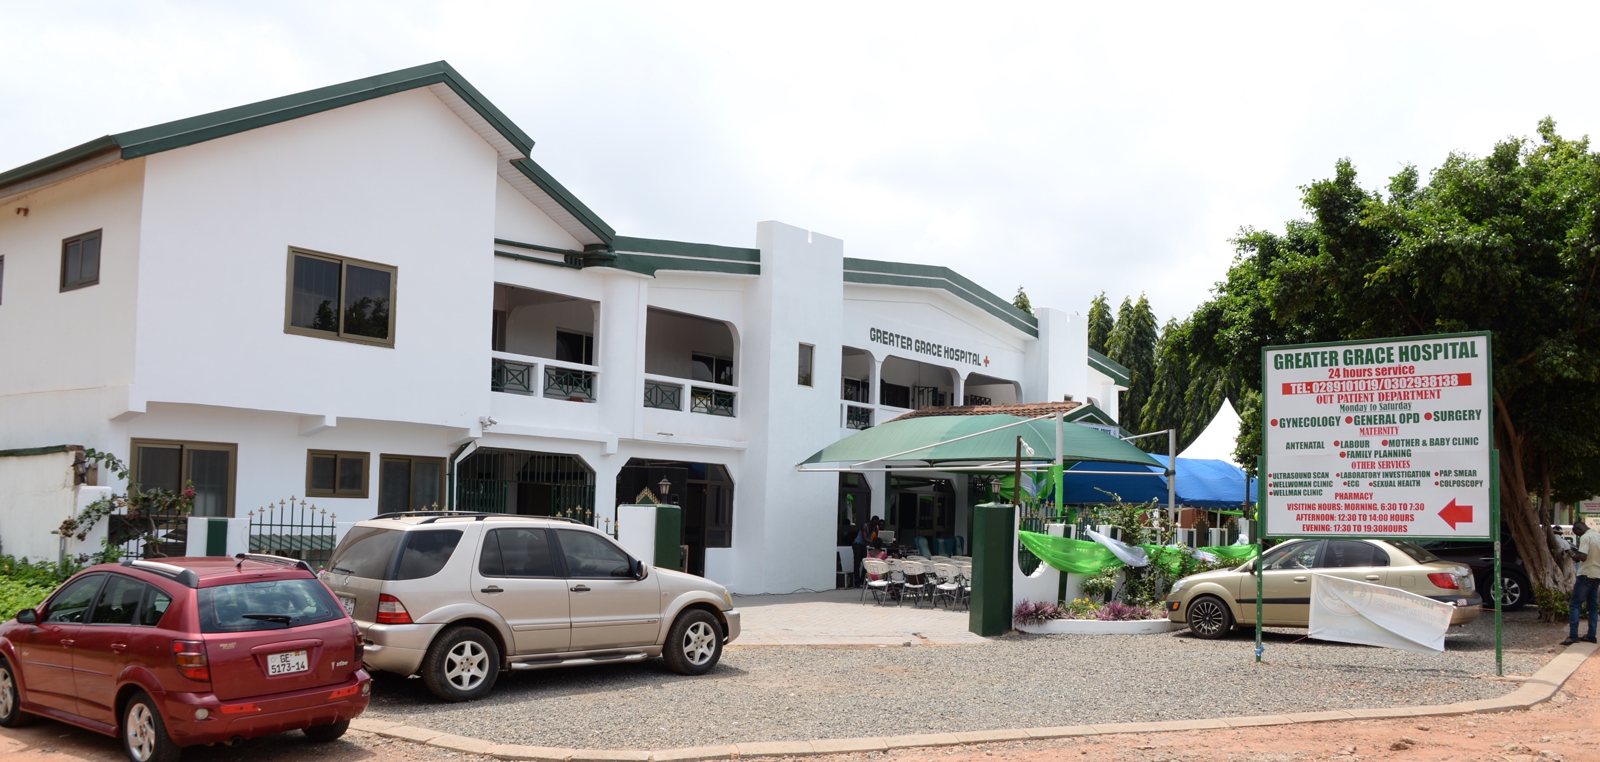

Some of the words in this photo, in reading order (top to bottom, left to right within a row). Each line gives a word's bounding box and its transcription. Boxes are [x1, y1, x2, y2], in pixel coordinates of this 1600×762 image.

[870, 328, 912, 350] GREATER
[914, 340, 942, 358] GRACE
[944, 346, 982, 366] HOSPITAL
[1274, 350, 1338, 370] GREATER
[1343, 346, 1394, 366] GRACE
[1398, 341, 1478, 362] HOSPITAL
[1328, 368, 1340, 378] 24
[1343, 367, 1372, 378] hours
[1375, 364, 1415, 376] service
[1316, 394, 1336, 404] OUT
[1338, 392, 1374, 404] PATIENT
[1378, 389, 1441, 402] DEPARTMENT
[1340, 404, 1367, 412] Monday
[1370, 403, 1377, 411] to
[1380, 402, 1412, 410] Saturday
[1280, 416, 1341, 428] GYNECOLOGY
[1354, 414, 1396, 426] GENERAL
[1399, 412, 1420, 424] OPD
[1433, 410, 1482, 422] SURGERY
[1360, 426, 1399, 436] MATERNITY
[1286, 441, 1325, 450] ANTENATAL
[1340, 440, 1370, 448] LABOUR
[1388, 439, 1420, 448] MOTHER
[1430, 438, 1450, 446] BABY
[1452, 437, 1478, 446] CLINIC
[1346, 450, 1372, 458] FAMILY
[1374, 449, 1412, 458] PLANNING
[1352, 461, 1376, 470] OTHER
[1378, 460, 1410, 468] SERVICES
[280, 654, 290, 663] GE
[272, 660, 306, 674] 5173-14
